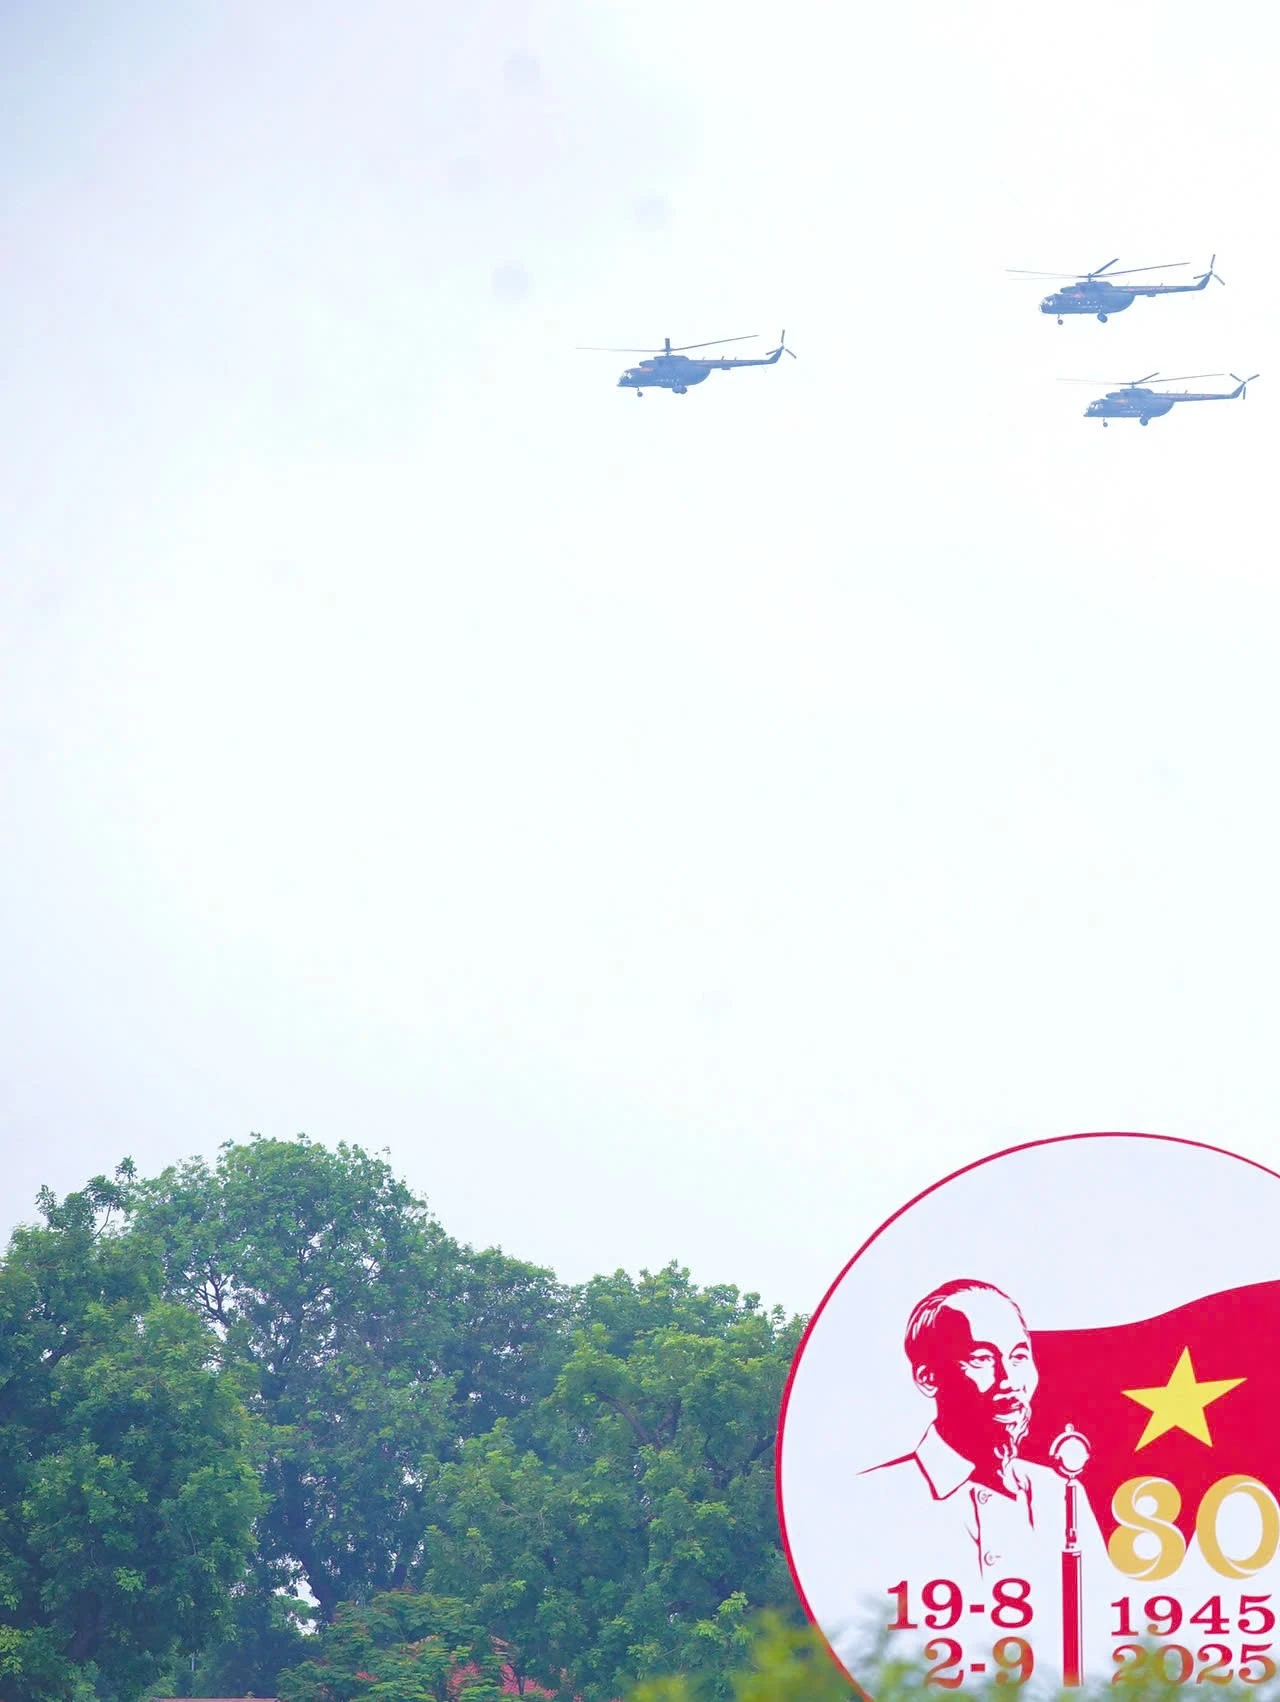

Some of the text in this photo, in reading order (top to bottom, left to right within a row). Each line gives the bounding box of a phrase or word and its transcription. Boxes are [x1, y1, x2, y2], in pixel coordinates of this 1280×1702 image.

[887, 1577, 1034, 1630] 19-8
[1111, 1594, 1276, 1636] 1945
[924, 1636, 1035, 1688] 2-9
[1112, 1642, 1278, 1685] 2025
